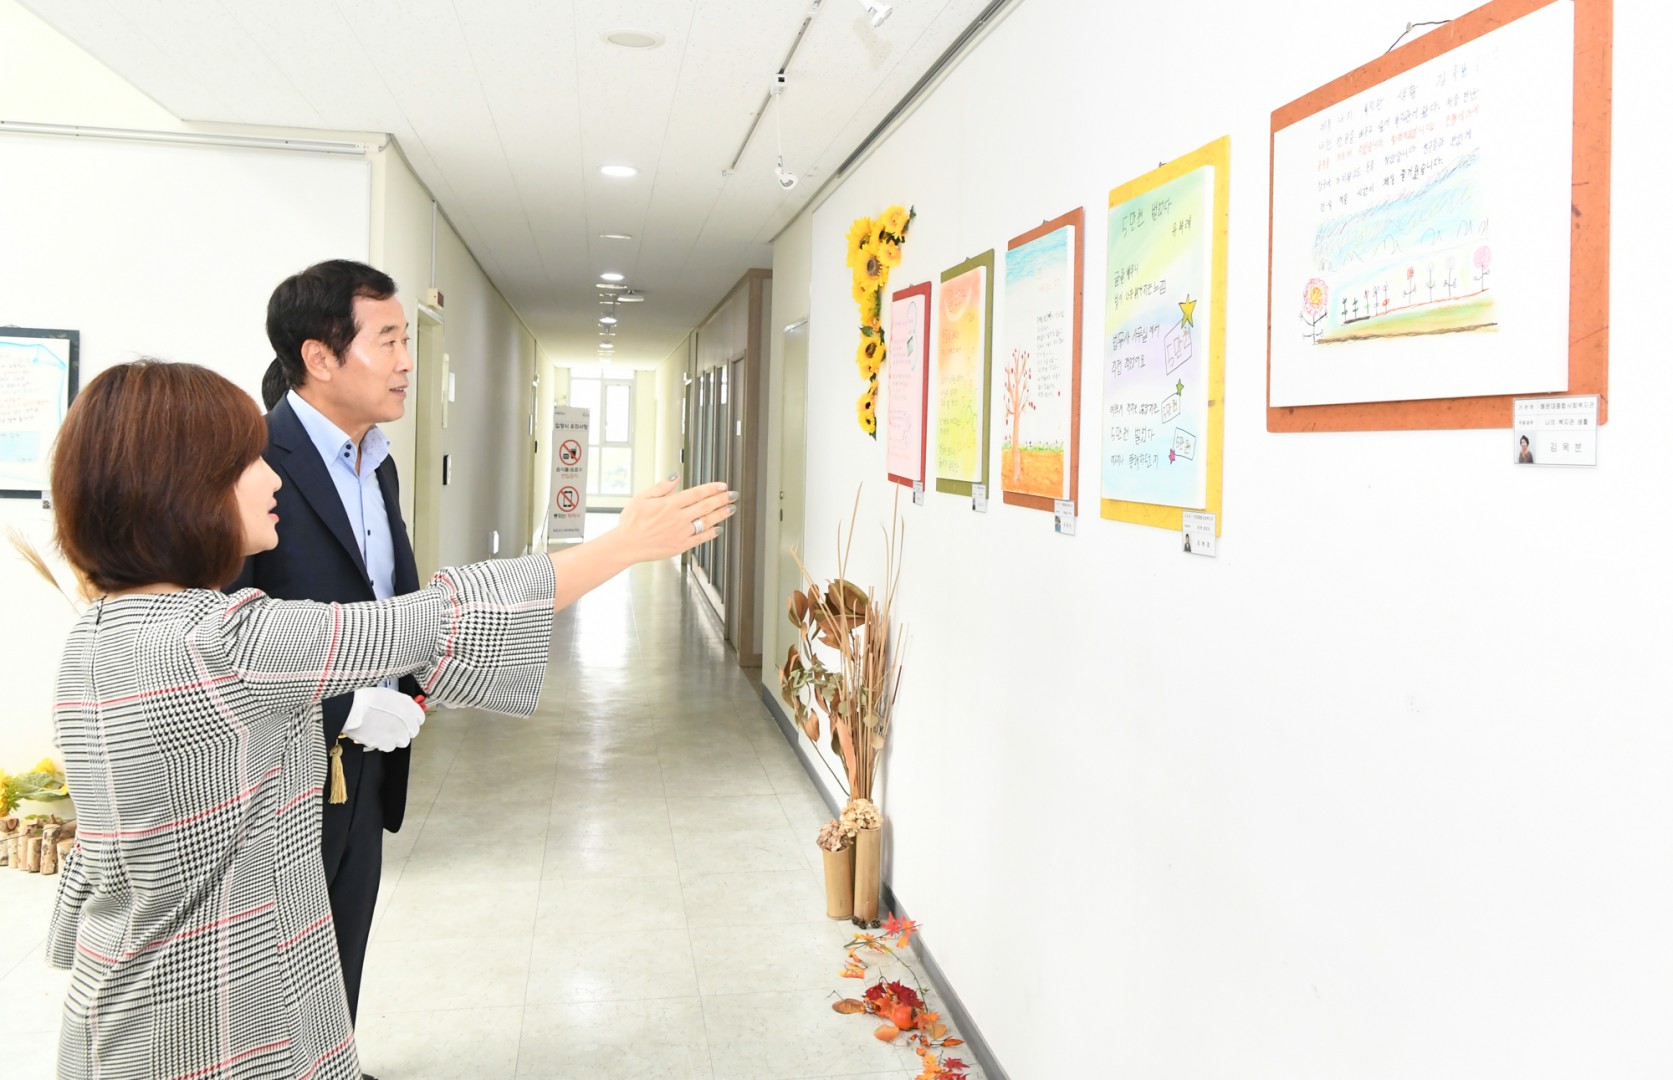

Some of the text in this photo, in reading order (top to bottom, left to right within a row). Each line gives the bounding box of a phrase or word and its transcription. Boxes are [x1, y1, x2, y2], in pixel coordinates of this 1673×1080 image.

[1122, 198, 1172, 237] 5만원 벌었다
[1111, 426, 1154, 445] 5만원 벌었다
